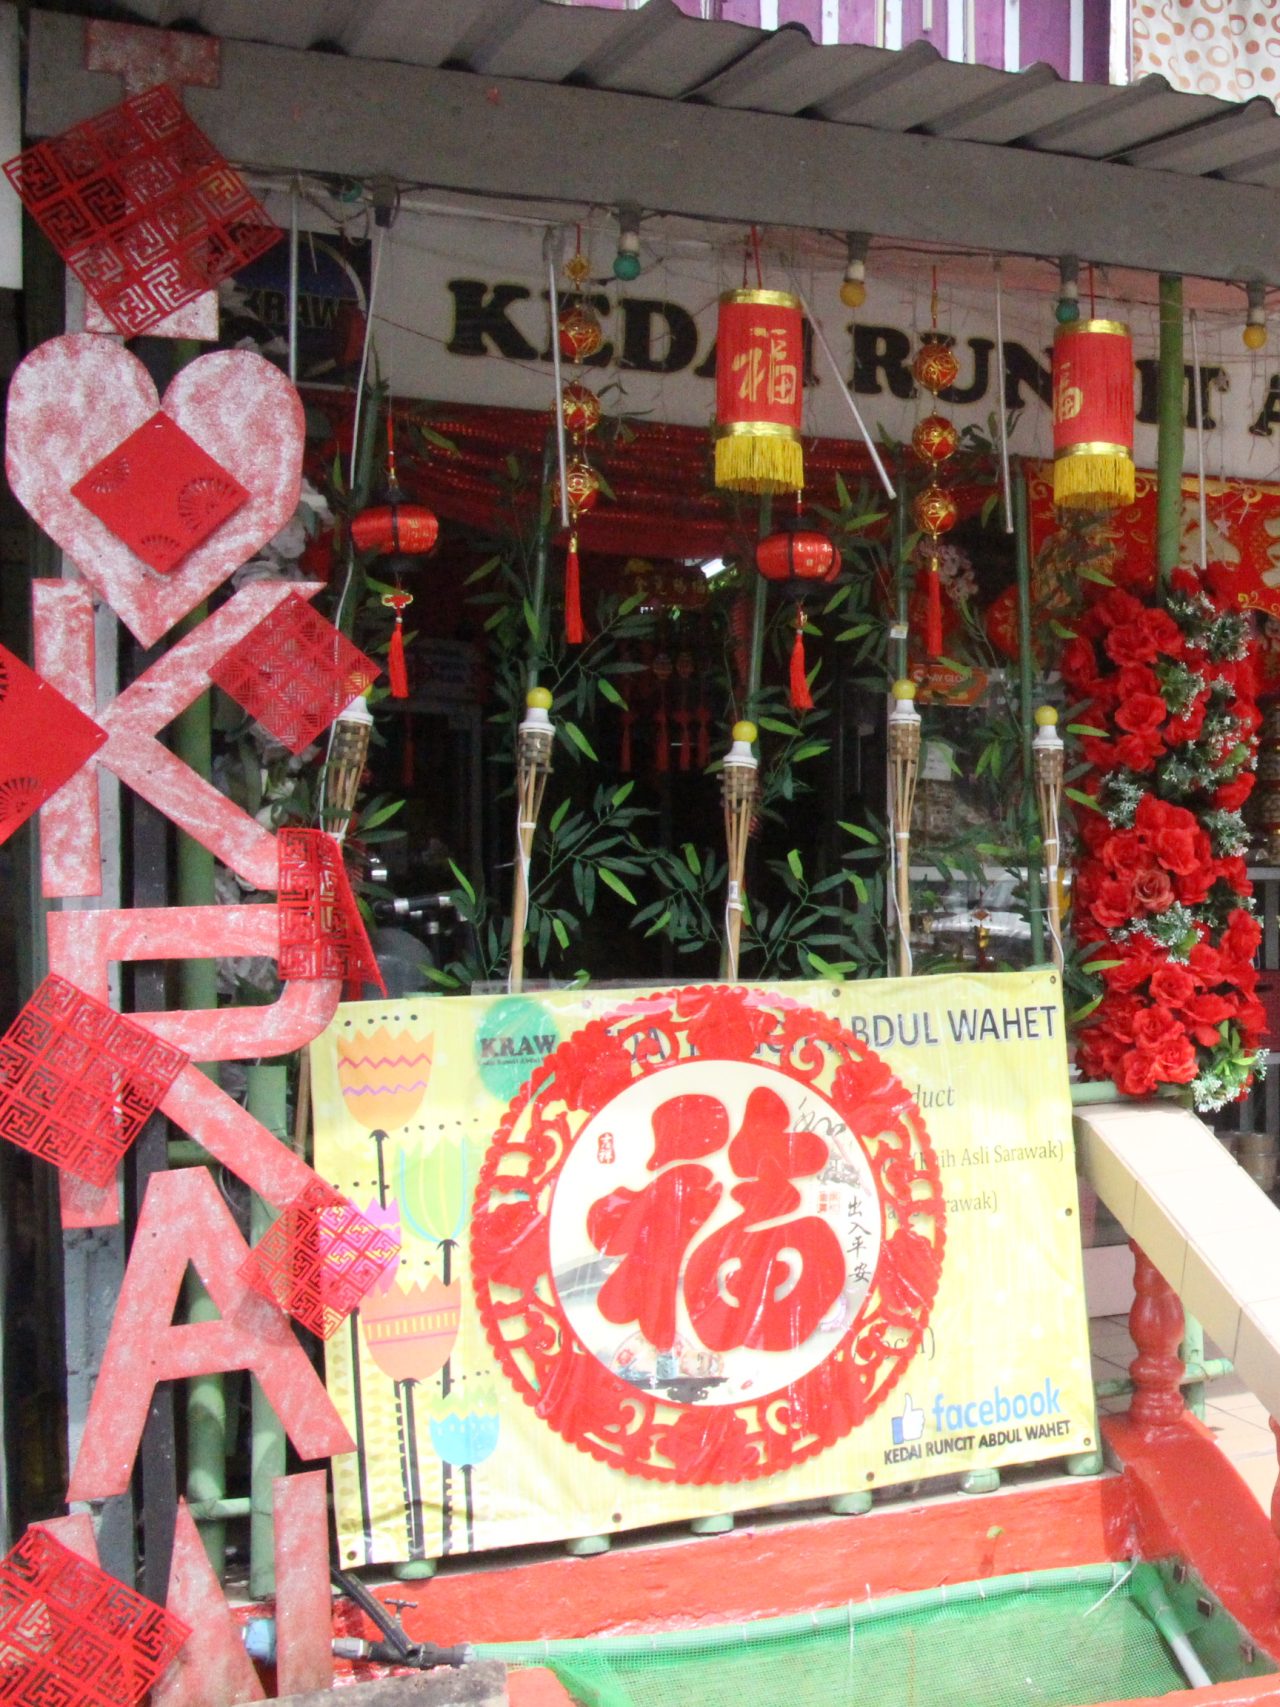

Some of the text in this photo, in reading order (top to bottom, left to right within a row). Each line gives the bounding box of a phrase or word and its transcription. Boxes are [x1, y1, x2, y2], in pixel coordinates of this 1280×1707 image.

[732, 326, 797, 405] 福
[848, 322, 1231, 430] RUNIT
[480, 1034, 556, 1058] KRAW
[947, 1006, 1057, 1043] WAHET
[961, 1146, 990, 1167] Asli
[994, 1139, 1064, 1164] Sarawak)
[585, 1085, 847, 1353] 福
[847, 1196, 872, 1283] 出入平安
[931, 1377, 1062, 1433] facebook
[884, 1419, 1071, 1465] KEDAI RUNCIT ABDUL WAHET
